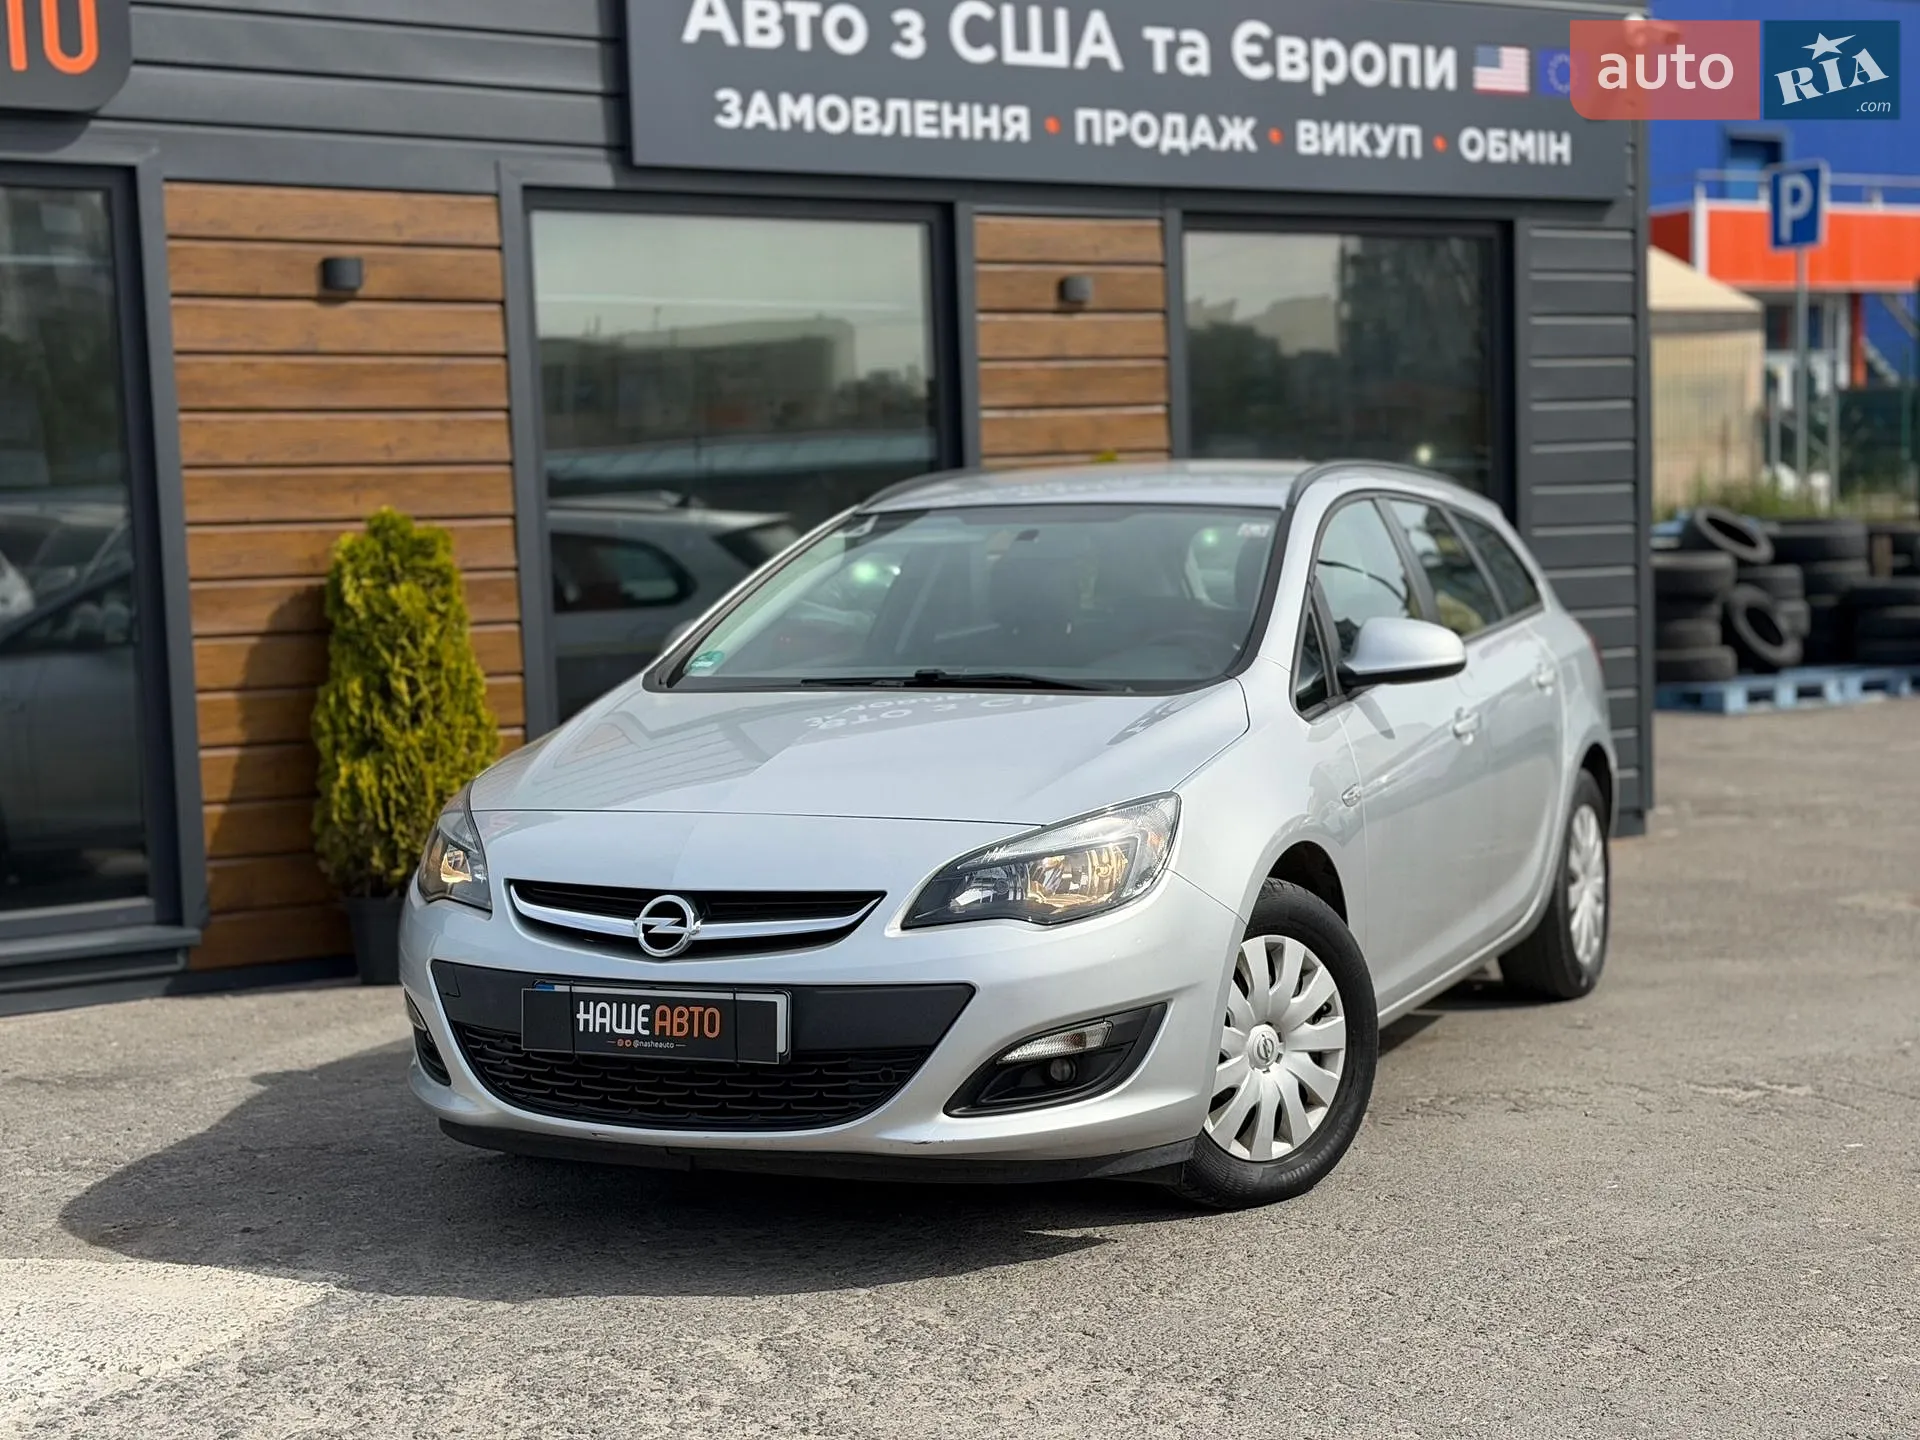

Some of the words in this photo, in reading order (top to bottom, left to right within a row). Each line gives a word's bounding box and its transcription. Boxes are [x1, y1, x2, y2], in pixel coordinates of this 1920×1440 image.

[949, 0, 1123, 72] США
[1143, 26, 1211, 77] та
[1231, 19, 1457, 96] Європи
[714, 88, 1031, 142] ЗАМОВЛЕННЯ
[1075, 108, 1258, 156] ПРОДАЖ
[1296, 120, 1422, 159] ВИКУП
[1459, 128, 1572, 165] ОБМІН
[1779, 173, 1815, 243] P
[576, 1001, 650, 1036] НАШЕ
[654, 1005, 721, 1038] АВТО
